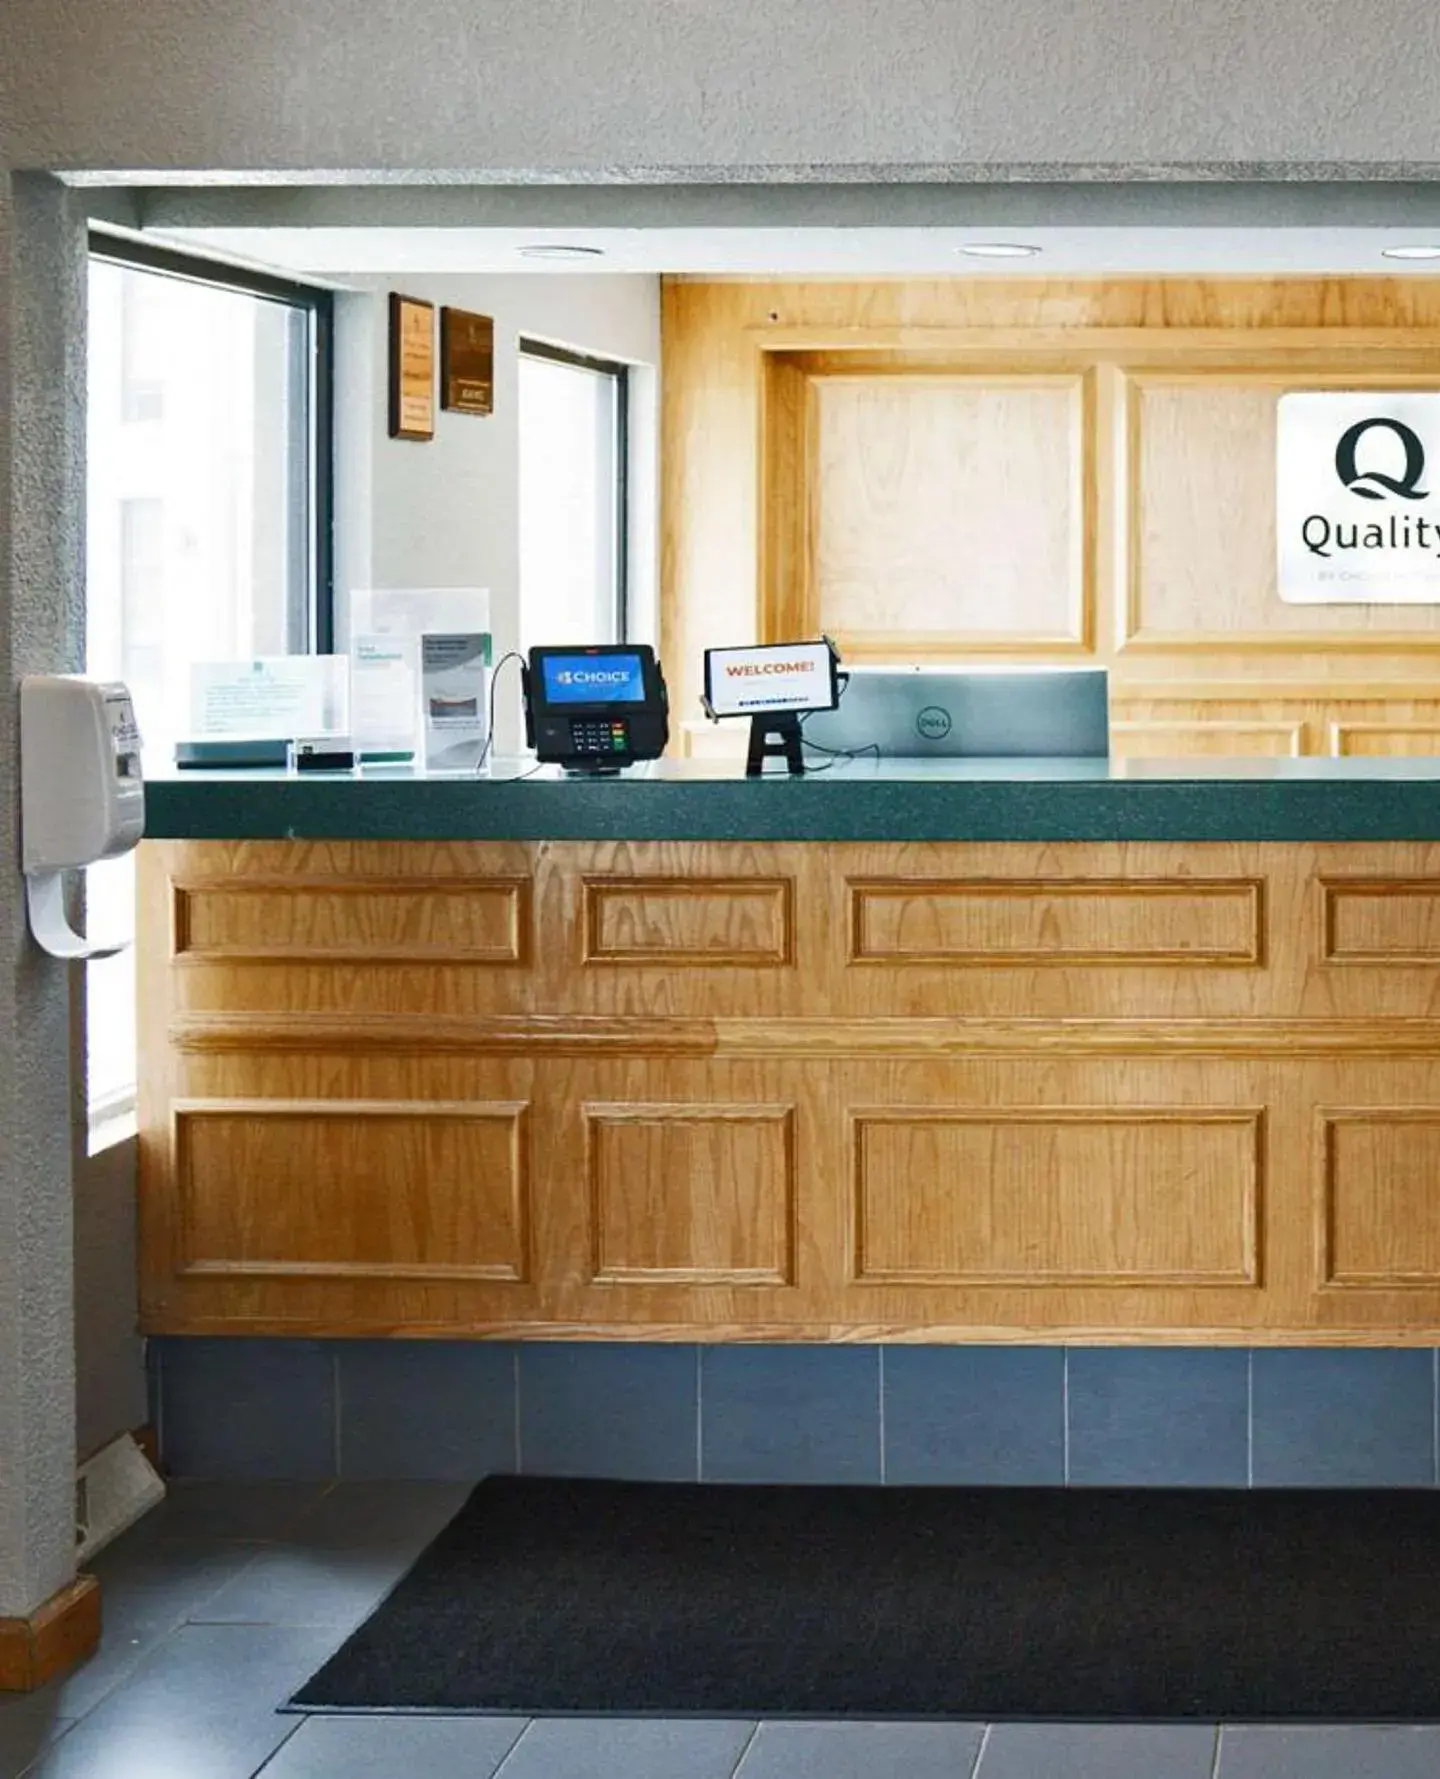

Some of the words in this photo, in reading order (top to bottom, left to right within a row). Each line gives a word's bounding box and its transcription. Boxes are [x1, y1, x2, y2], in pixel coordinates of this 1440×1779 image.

[1335, 417, 1430, 500] Q
[726, 661, 815, 676] WELCOME!
[573, 671, 630, 683] CHOICE
[921, 718, 947, 728] DELL
